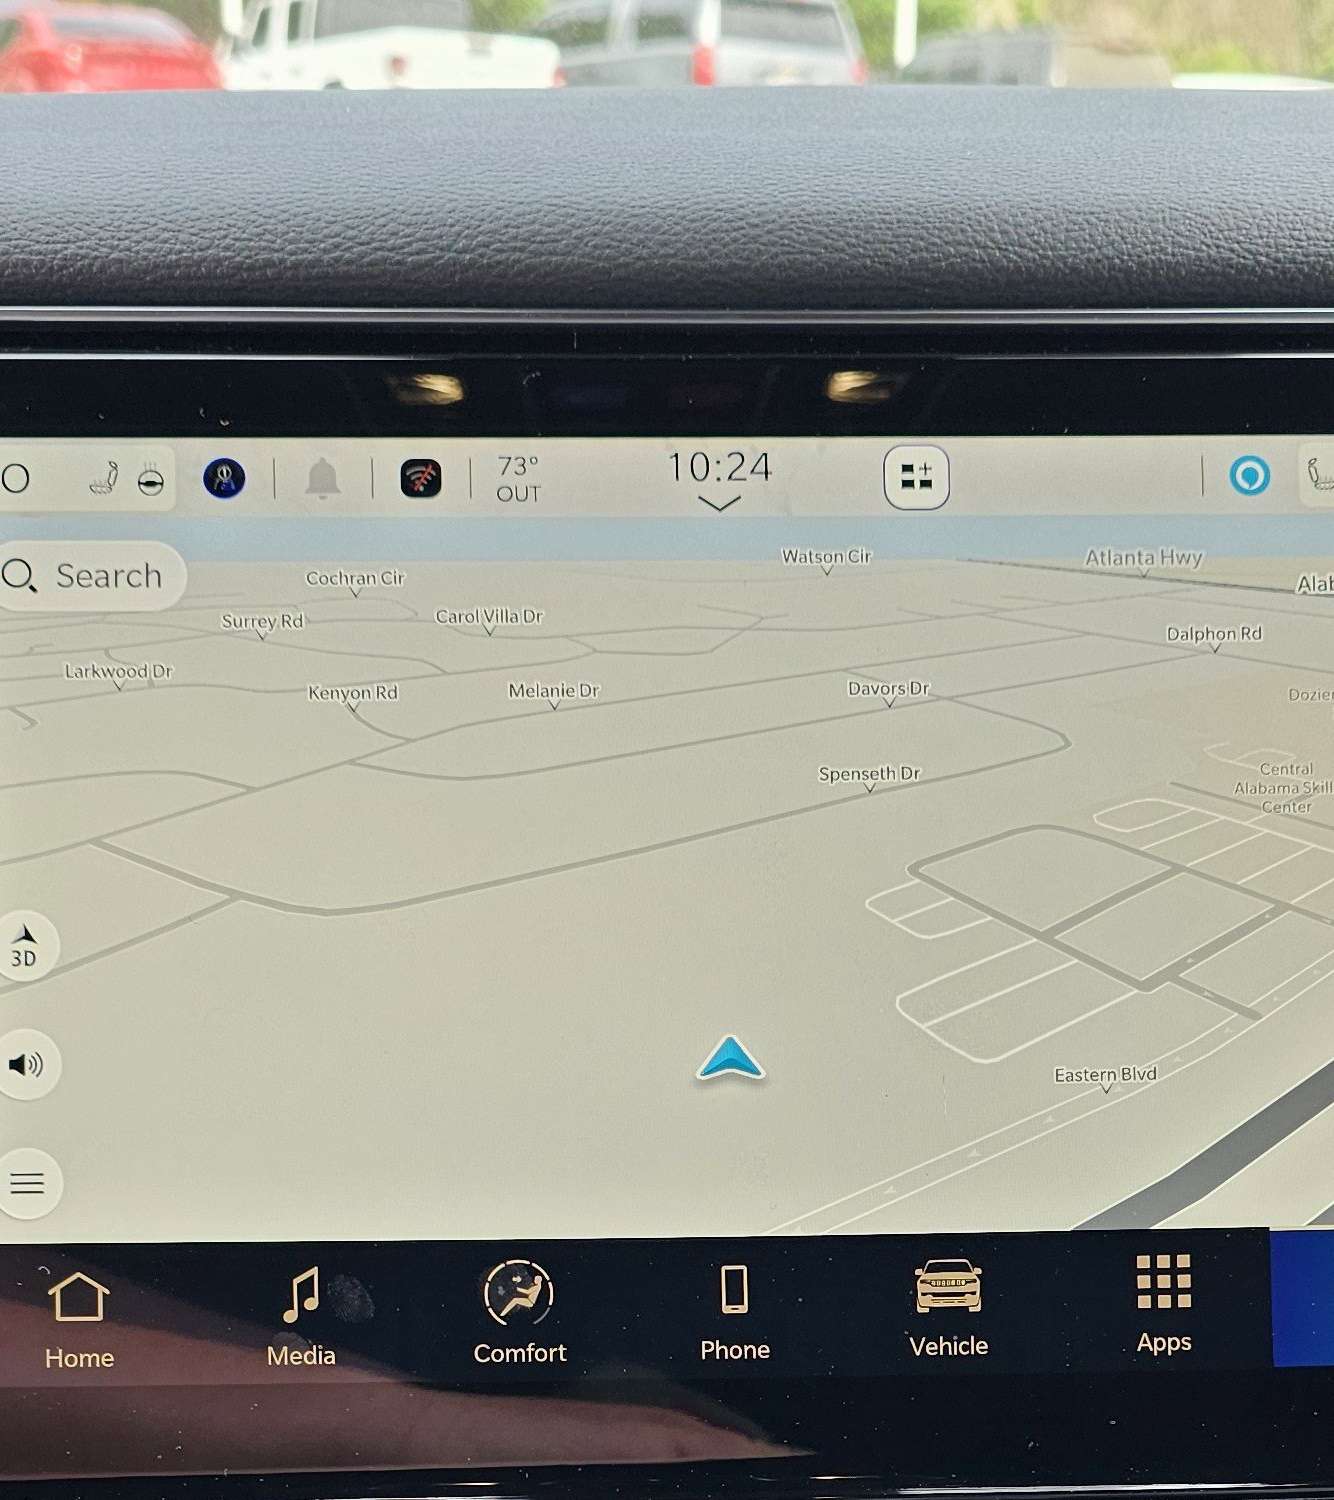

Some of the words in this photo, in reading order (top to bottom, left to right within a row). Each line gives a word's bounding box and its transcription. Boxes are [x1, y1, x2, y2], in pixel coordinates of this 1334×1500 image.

[668, 452, 774, 483] 10:24
[496, 486, 541, 502] OUT
[782, 549, 844, 564] Watson
[848, 548, 872, 564] Cir
[1085, 549, 1155, 566] Atlanta
[1160, 549, 1203, 570] Hwy
[56, 562, 162, 589] Search
[306, 570, 376, 586] Cochran
[380, 570, 405, 586] Cir
[222, 614, 277, 632] Surrey
[281, 613, 304, 629] Rd
[436, 608, 479, 624] Carol
[483, 608, 519, 624] Villa
[523, 609, 544, 624] Dr
[1167, 626, 1236, 644] Dalphon
[1241, 626, 1262, 641] Rd
[65, 662, 149, 679] Larkwood
[153, 664, 172, 679] Dr
[308, 685, 372, 704] Kenyon
[376, 684, 399, 700] Rd
[509, 683, 574, 699] Melanie
[579, 683, 600, 698] Dr
[848, 681, 906, 697] Davors
[911, 681, 929, 697] Dr
[819, 766, 897, 784] Spenseth
[902, 766, 921, 781] Dr
[1260, 762, 1313, 775] Central
[1234, 782, 1299, 794] Alabama
[1262, 801, 1313, 814] Center
[11, 949, 37, 968] 3D
[1054, 1068, 1117, 1083] Eastern
[1121, 1066, 1158, 1081] Blvd
[473, 1342, 568, 1364] Comfort
[700, 1339, 771, 1360] Phone
[909, 1335, 989, 1357] Vehicle
[1136, 1333, 1192, 1357] Apps
[45, 1348, 115, 1369] Home
[267, 1345, 336, 1367] Media
